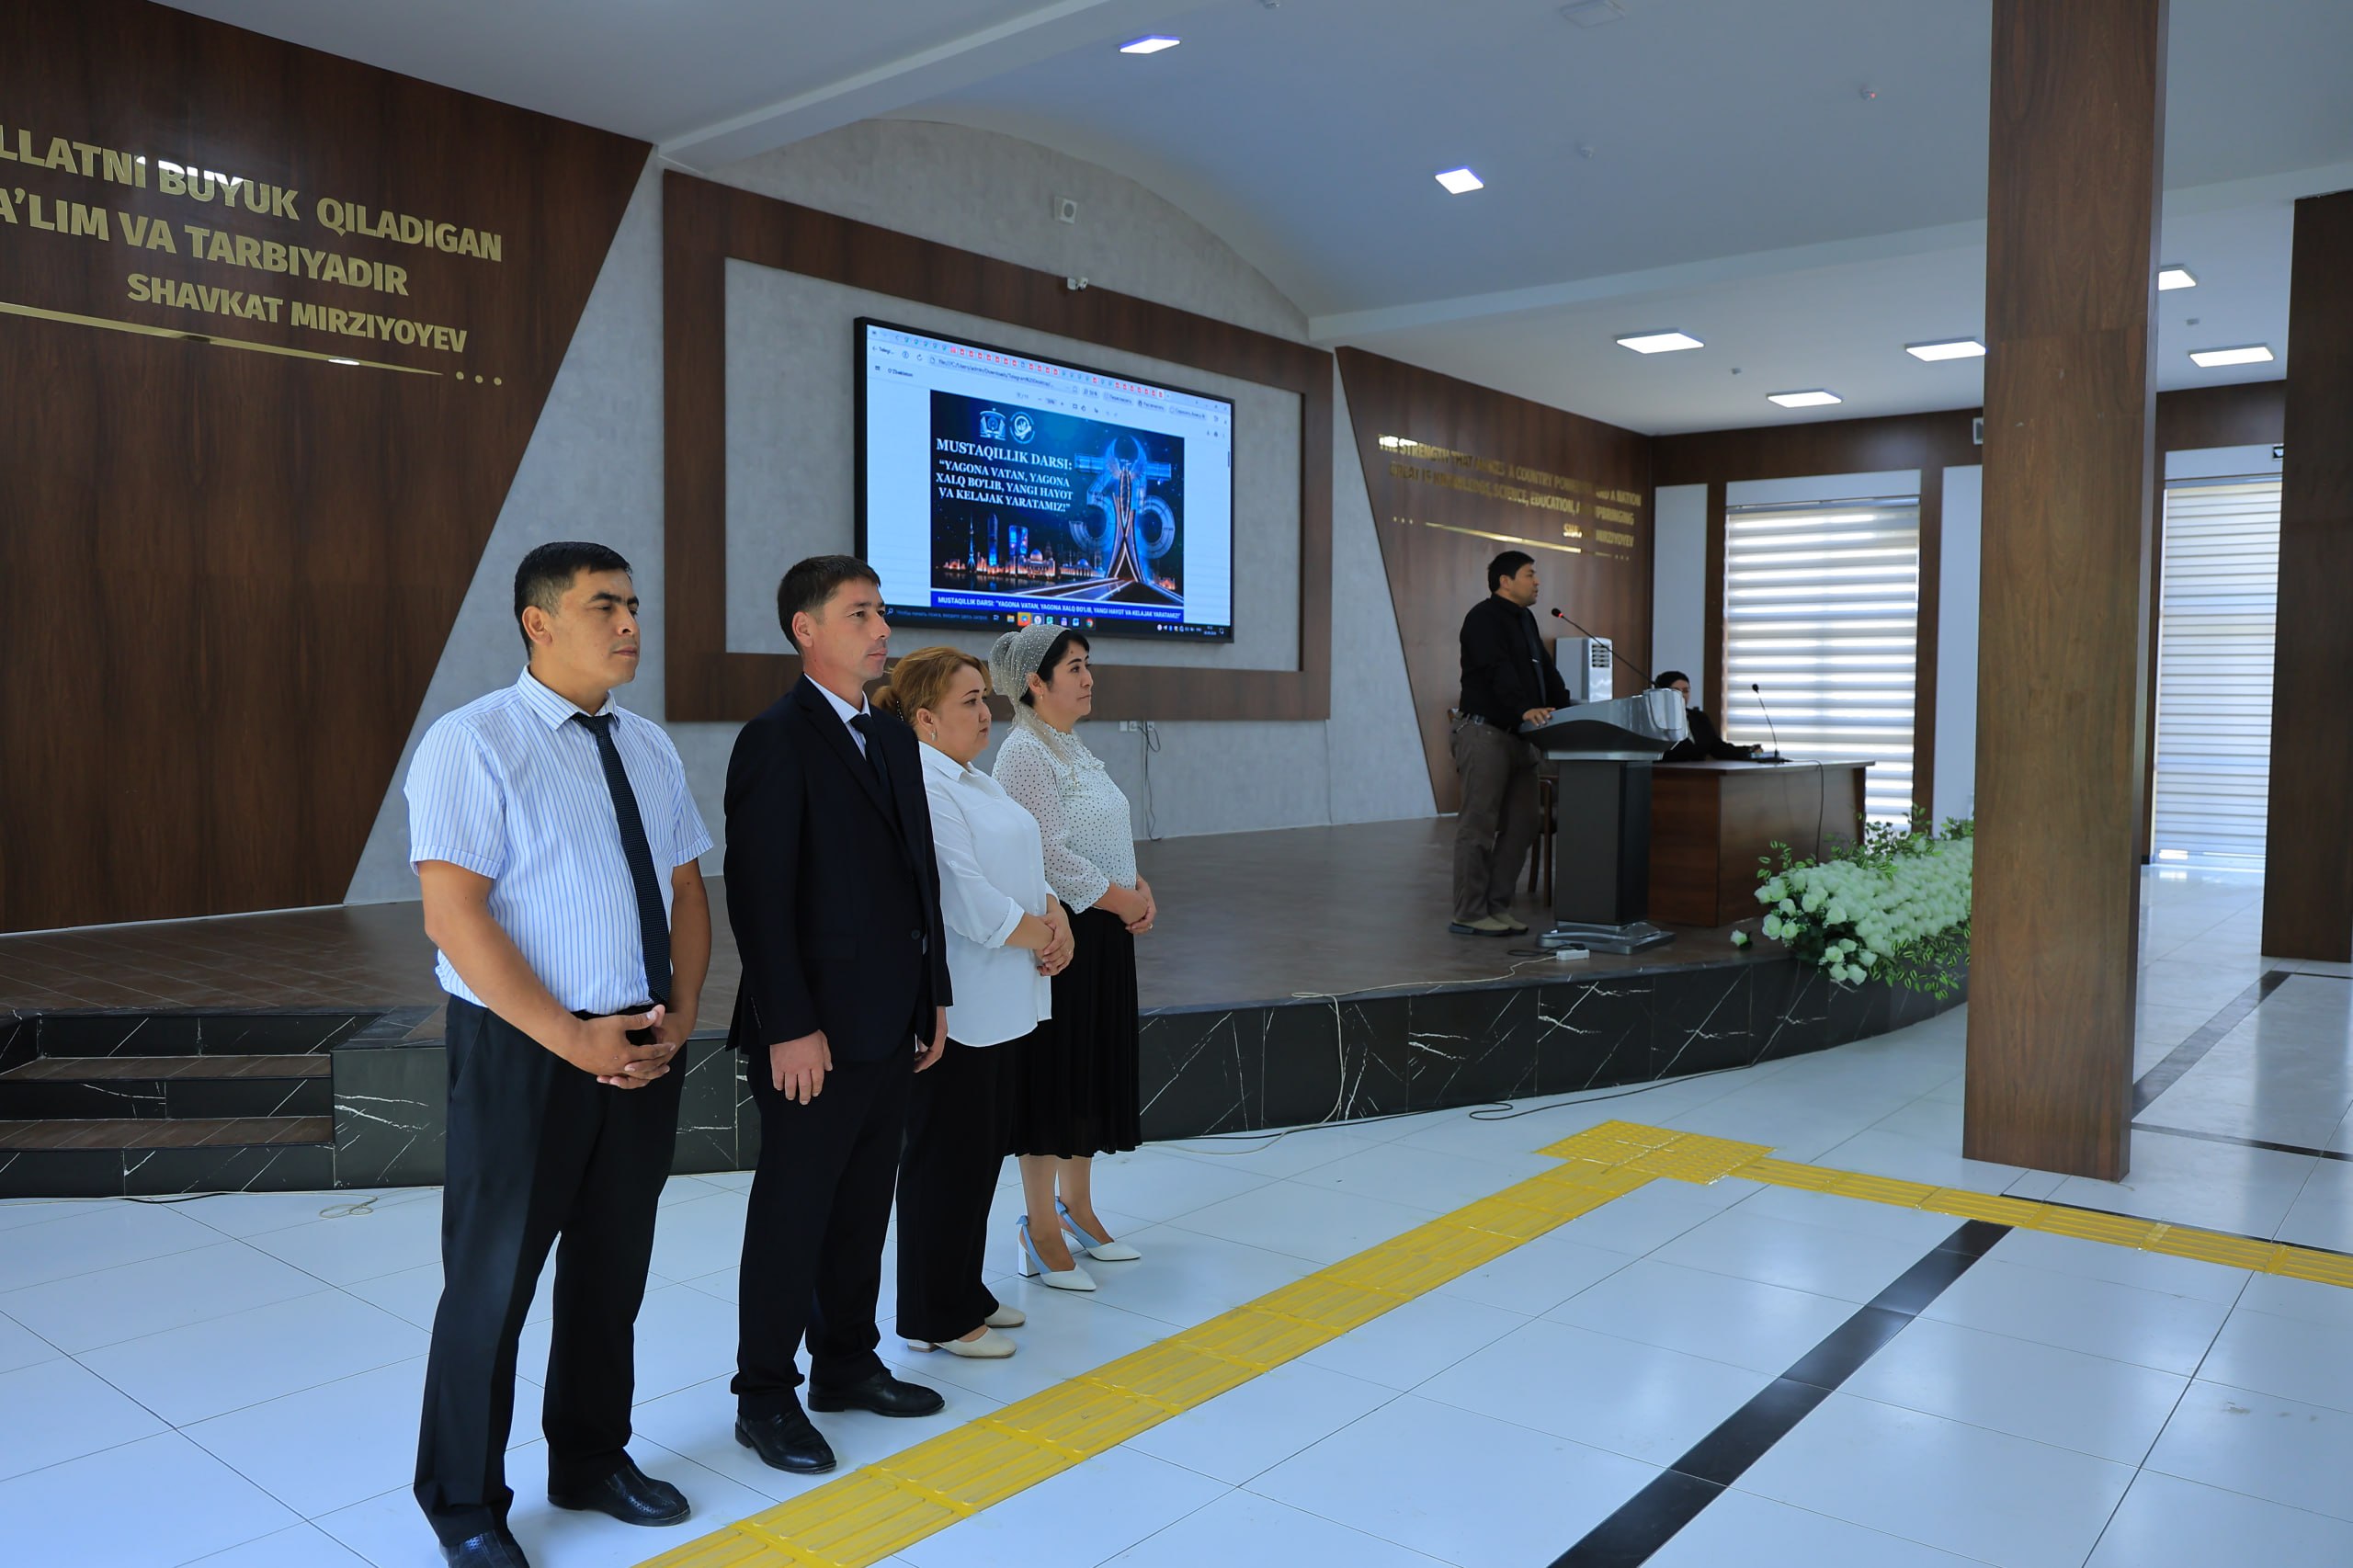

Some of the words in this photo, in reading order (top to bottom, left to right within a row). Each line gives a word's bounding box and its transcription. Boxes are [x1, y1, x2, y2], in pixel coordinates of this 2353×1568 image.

[0, 124, 146, 188] LLATNI
[158, 159, 300, 221] BUYUK
[316, 198, 503, 262] QILADIGAN
[118, 211, 176, 254] VA
[184, 224, 409, 296] TARBIYADIR
[127, 273, 284, 323] SHAVKAT
[290, 301, 468, 353] MIRZIYOYEV
[936, 438, 1029, 463] MUSTAQILLIK
[1030, 453, 1073, 471] DARSI:
[936, 472, 966, 488] XALQ
[1006, 483, 1038, 495] YANGI
[1040, 487, 1074, 501] HAYOT
[991, 467, 1029, 483] VATAN,
[1029, 472, 1070, 487] YAGONA
[1517, 466, 1553, 488] COUNTRY
[938, 487, 954, 499] VA
[956, 490, 1004, 505] KELAJAK
[1530, 491, 1576, 517] EDUCATION,
[938, 597, 976, 607] MUSTAQILLIK
[1040, 603, 1062, 611] YAGONA
